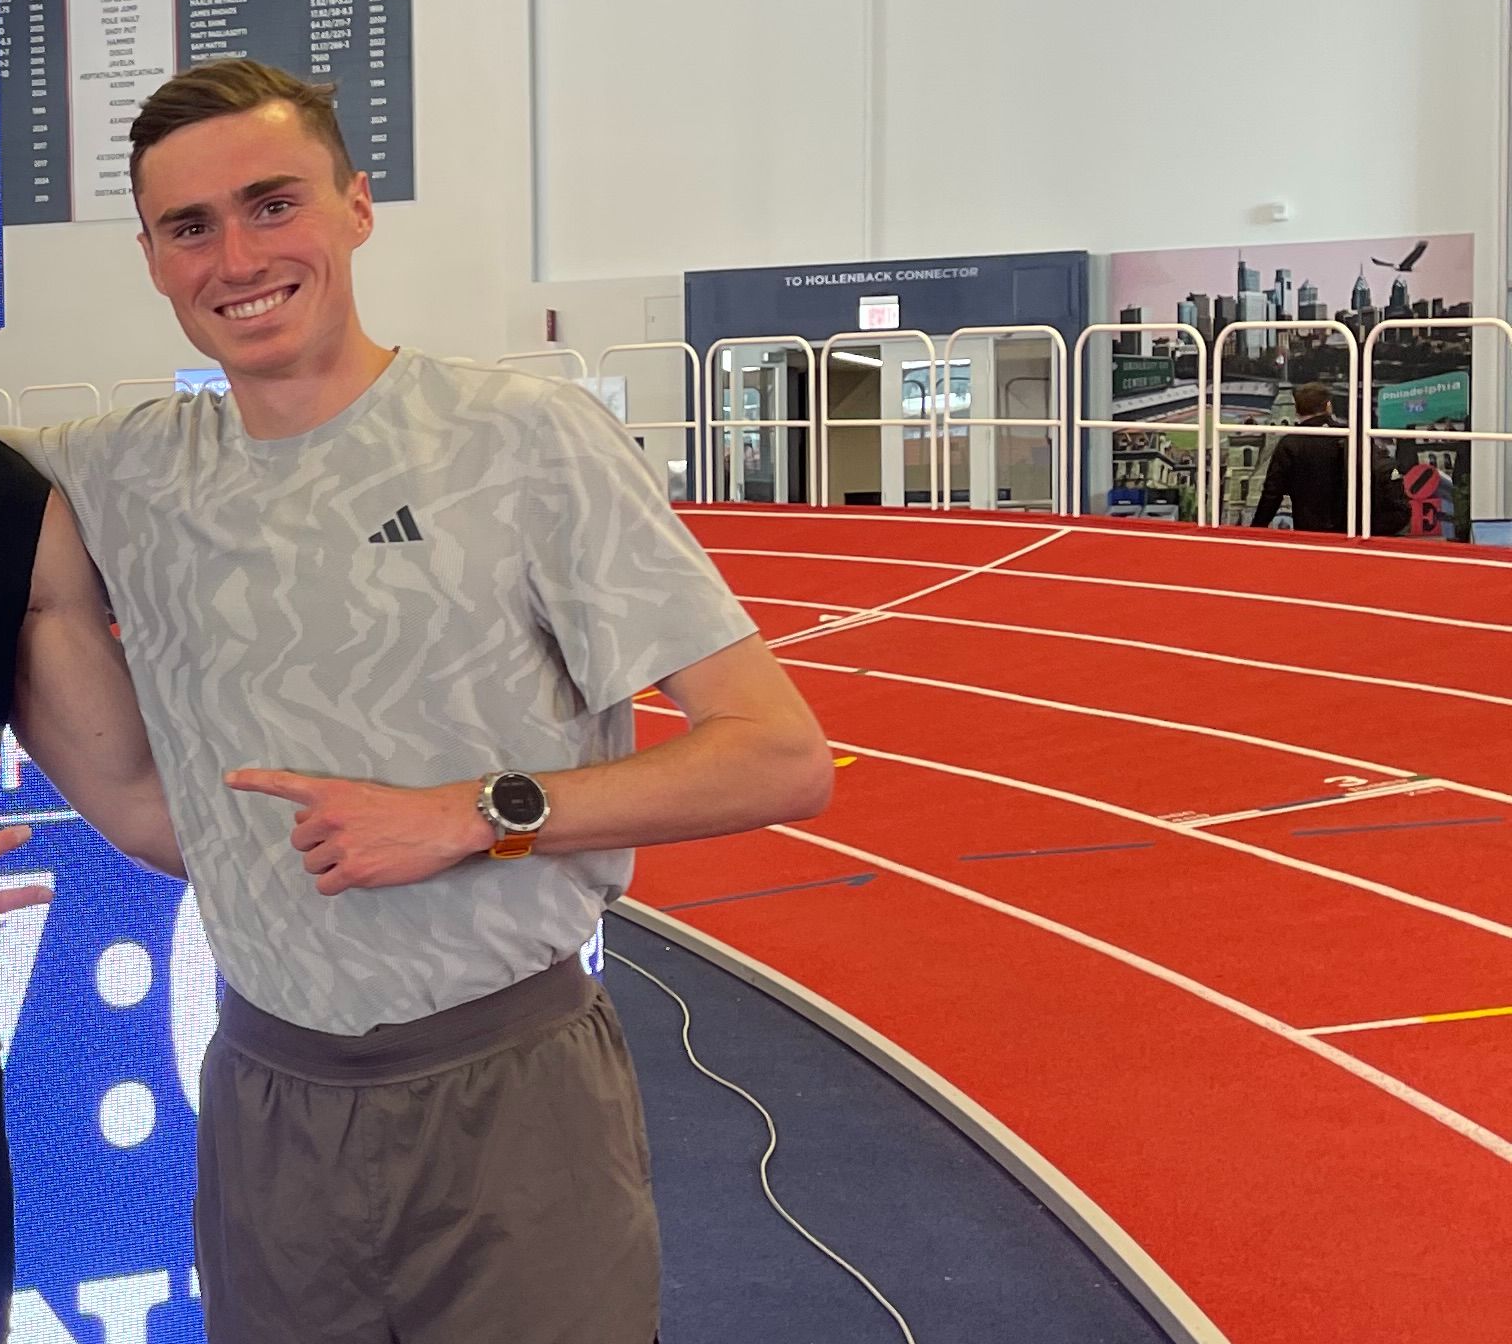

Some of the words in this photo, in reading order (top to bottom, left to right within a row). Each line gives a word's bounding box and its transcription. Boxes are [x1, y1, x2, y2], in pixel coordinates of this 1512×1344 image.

[784, 276, 802, 287] TO
[805, 271, 893, 286] HOLLENBACK
[895, 267, 979, 281] CONNECTOR
[1383, 381, 1462, 401] Philadelphia
